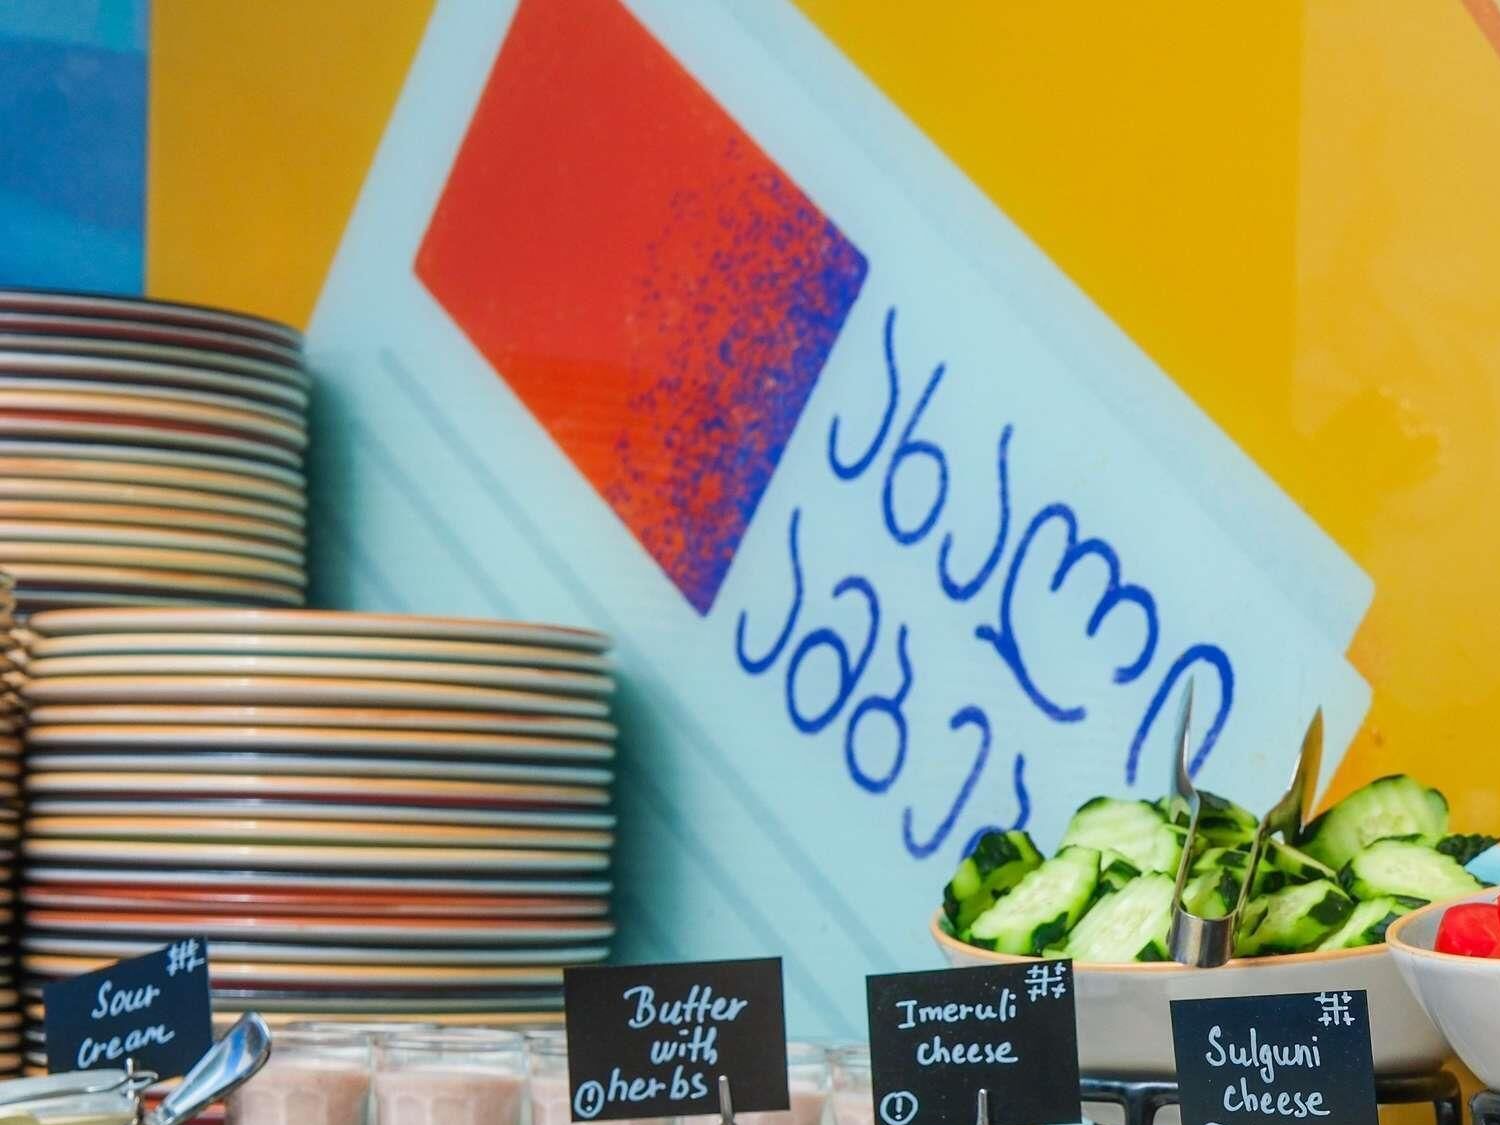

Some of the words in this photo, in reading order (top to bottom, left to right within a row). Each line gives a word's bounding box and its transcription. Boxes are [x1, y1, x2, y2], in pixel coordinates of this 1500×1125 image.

[91, 979, 161, 1019] Sour
[622, 984, 748, 1029] Butter
[895, 988, 1017, 1029] Imeruli
[650, 1026, 718, 1065] with
[916, 1035, 1019, 1066] cheese
[1205, 1025, 1321, 1084] Sulguni
[607, 1064, 709, 1101] herbs
[1223, 1076, 1331, 1118] cheese
